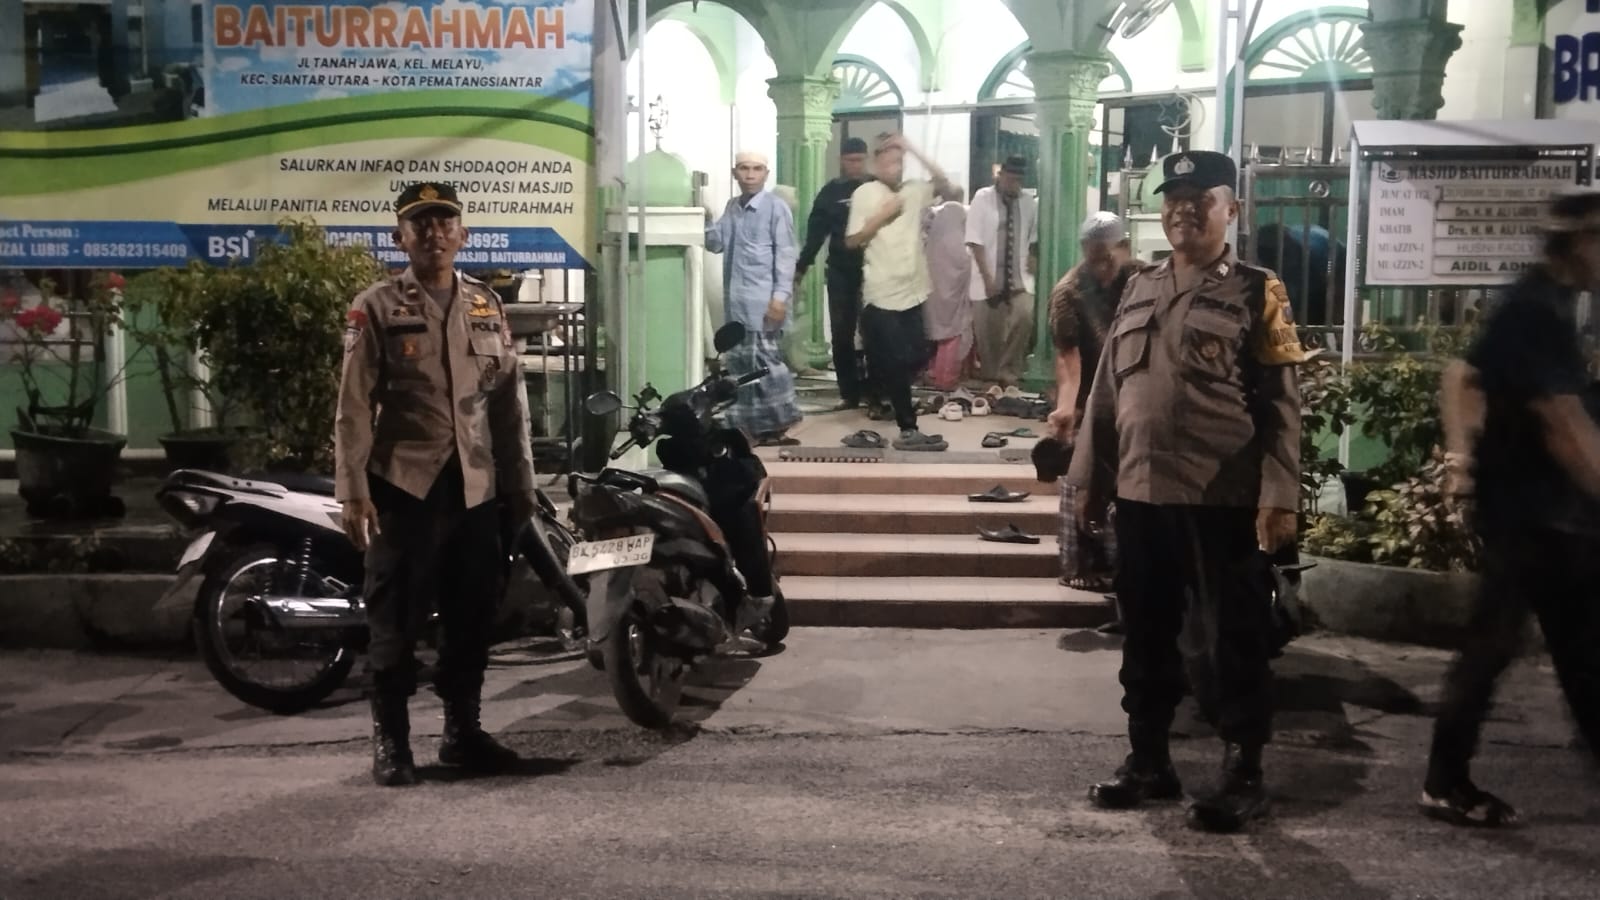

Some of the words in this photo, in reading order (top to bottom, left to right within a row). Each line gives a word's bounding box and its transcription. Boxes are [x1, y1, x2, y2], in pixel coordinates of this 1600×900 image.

[215, 6, 565, 49] BAITURRAHMAH
[313, 57, 357, 68] TANAH
[432, 58, 484, 71] MELAYU,
[1554, 31, 1600, 104] BA
[240, 74, 268, 84] KEC.
[271, 74, 325, 86] SIANTAR
[328, 75, 369, 86] UTARA
[382, 75, 416, 86] KOTA
[419, 76, 543, 88] PEMATANGSIANTAR
[280, 158, 357, 171] SALURKAN
[360, 160, 405, 174] INFAQ
[408, 160, 440, 173] DAN
[443, 161, 527, 175] SHODAQOH
[531, 162, 573, 173] ANDA
[1408, 165, 1457, 179] MASJID
[518, 182, 573, 194] MASJID
[208, 199, 268, 211] MELALUI
[271, 199, 328, 212] PANITIA
[332, 200, 398, 213] RENOVAS
[467, 201, 574, 214] BAITURAHMAH
[1380, 207, 1404, 216] IMAM
[22, 224, 73, 238] Person
[30, 242, 69, 256] LUBIS
[208, 234, 252, 258] BSI
[1451, 261, 1492, 271] AIDIL
